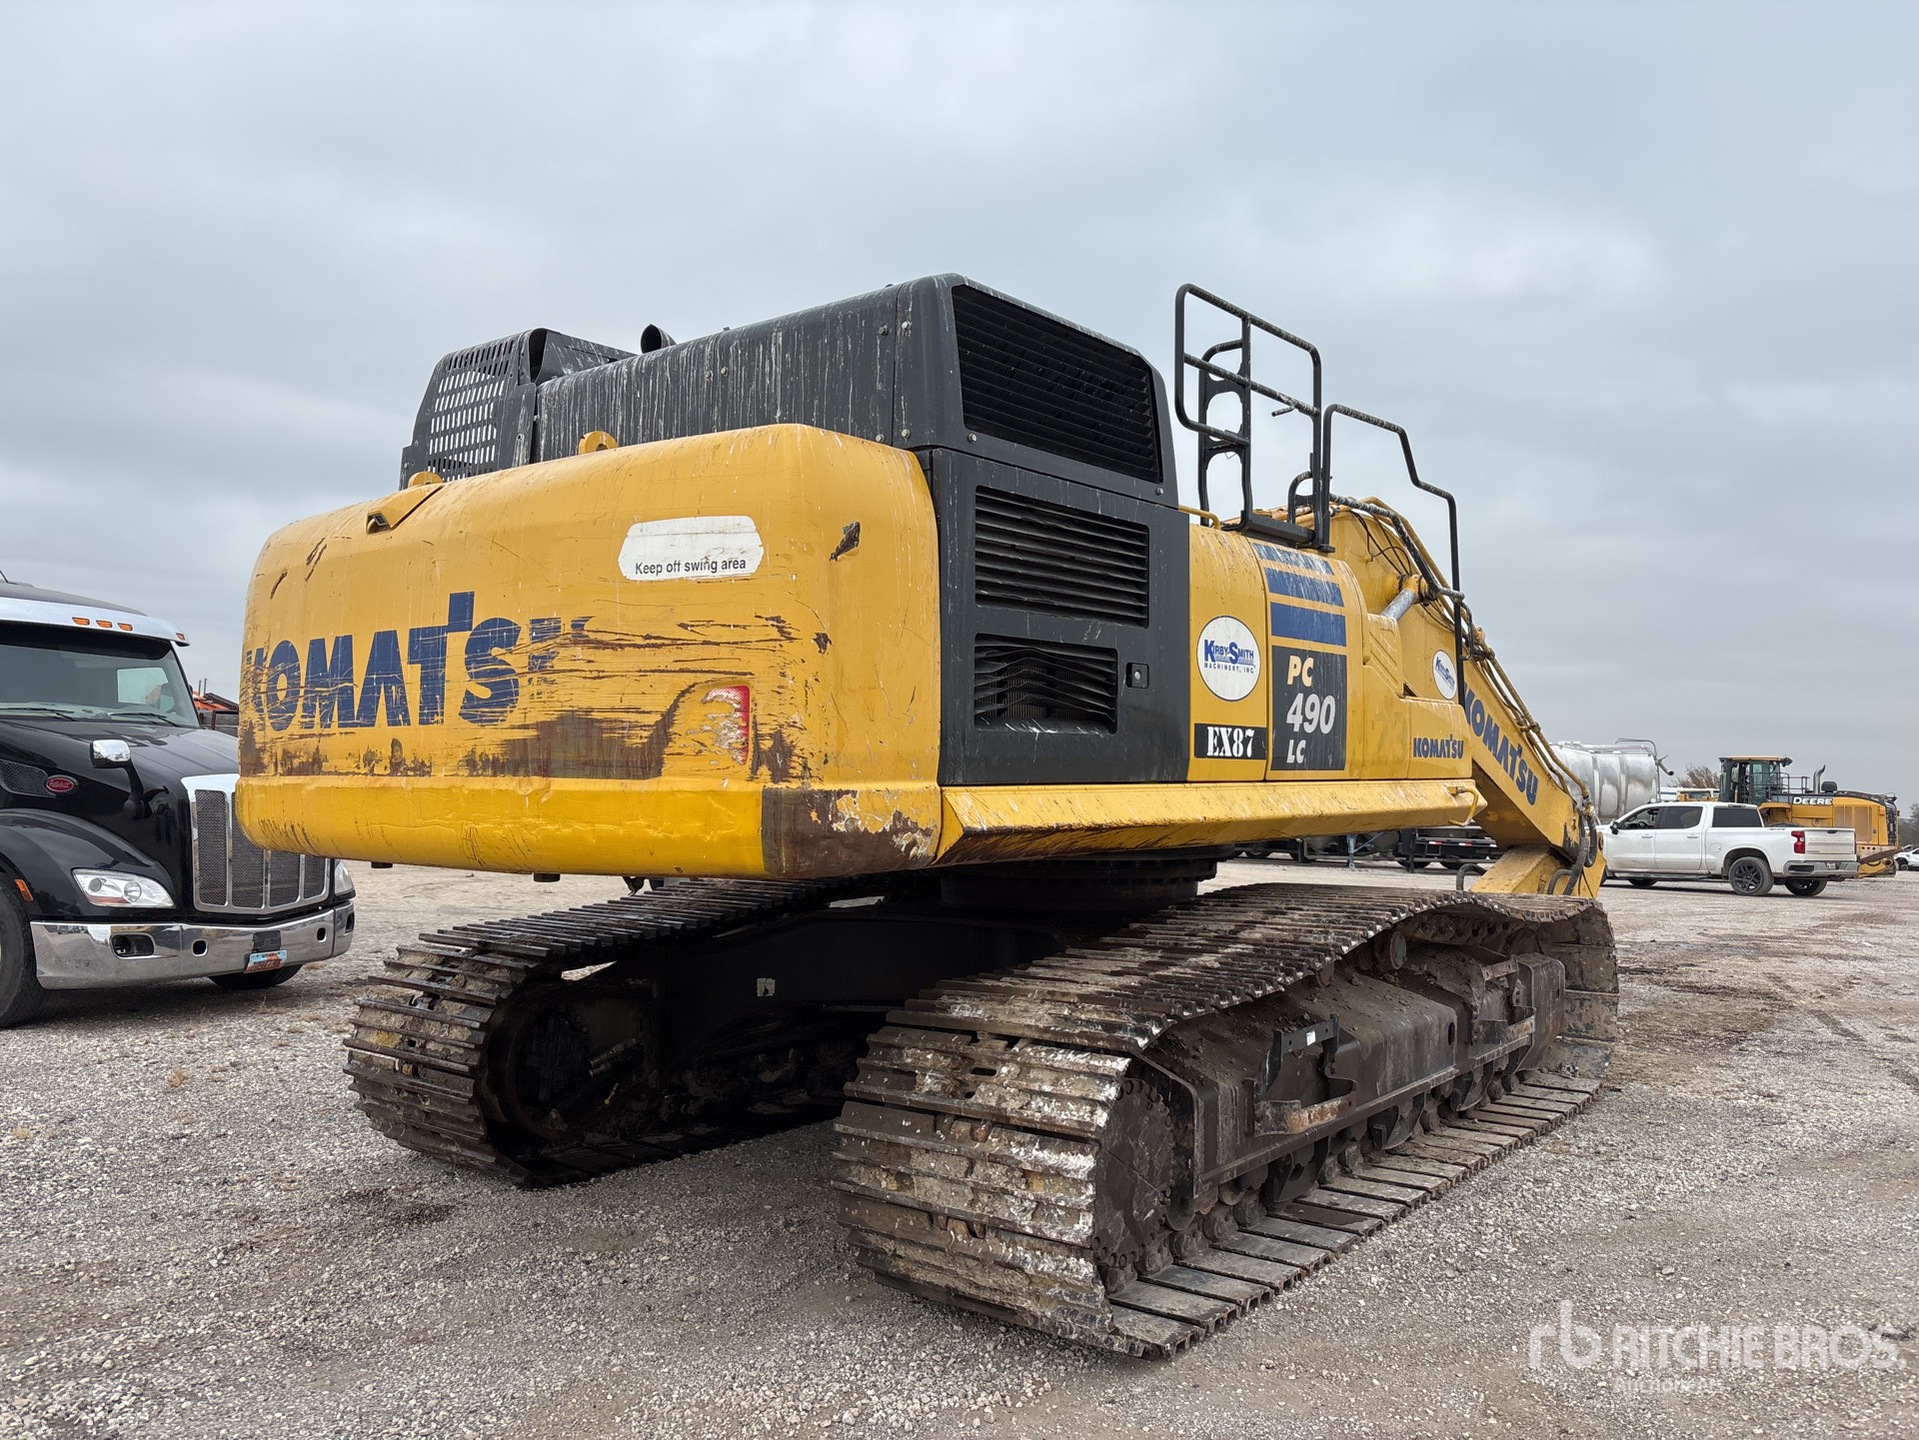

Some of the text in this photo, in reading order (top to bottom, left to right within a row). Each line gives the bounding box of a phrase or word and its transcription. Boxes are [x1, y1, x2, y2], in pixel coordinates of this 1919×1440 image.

[635, 559, 746, 577] Keep off swing area
[1204, 639, 1255, 665] KIRBY-SMITH
[1287, 655, 1314, 687] PC
[1286, 693, 1336, 734] 490
[1206, 726, 1255, 758] EX87
[1286, 739, 1306, 763] LC
[1413, 734, 1464, 759] KOMATSU
[1793, 797, 1833, 805] DEERE
